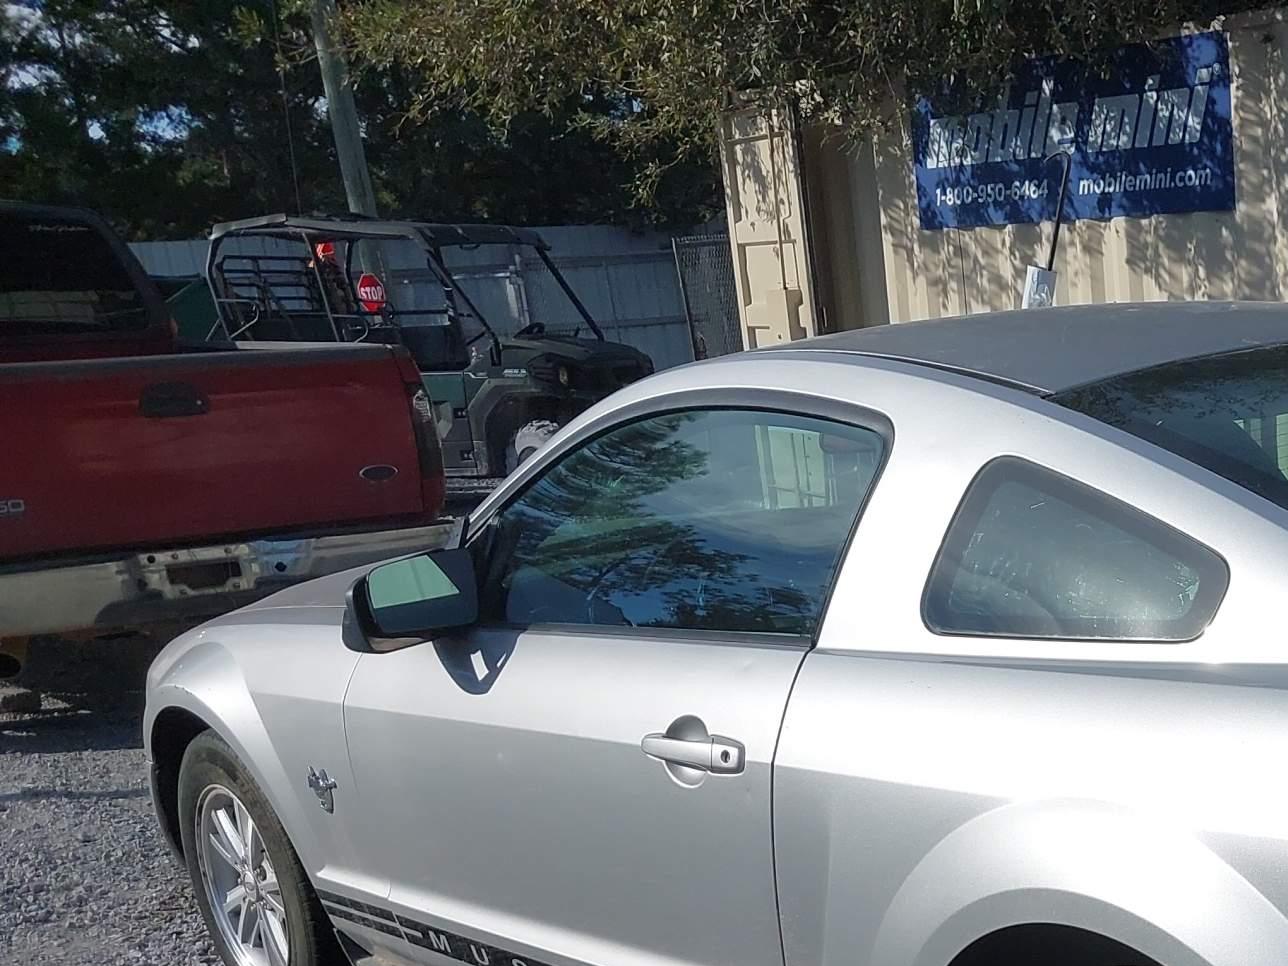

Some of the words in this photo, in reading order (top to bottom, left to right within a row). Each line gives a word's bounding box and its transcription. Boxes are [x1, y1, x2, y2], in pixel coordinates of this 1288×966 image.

[935, 178, 1048, 207] 1-800-950-6464
[1079, 167, 1211, 196] mobilemini.com
[360, 286, 383, 301] STOP
